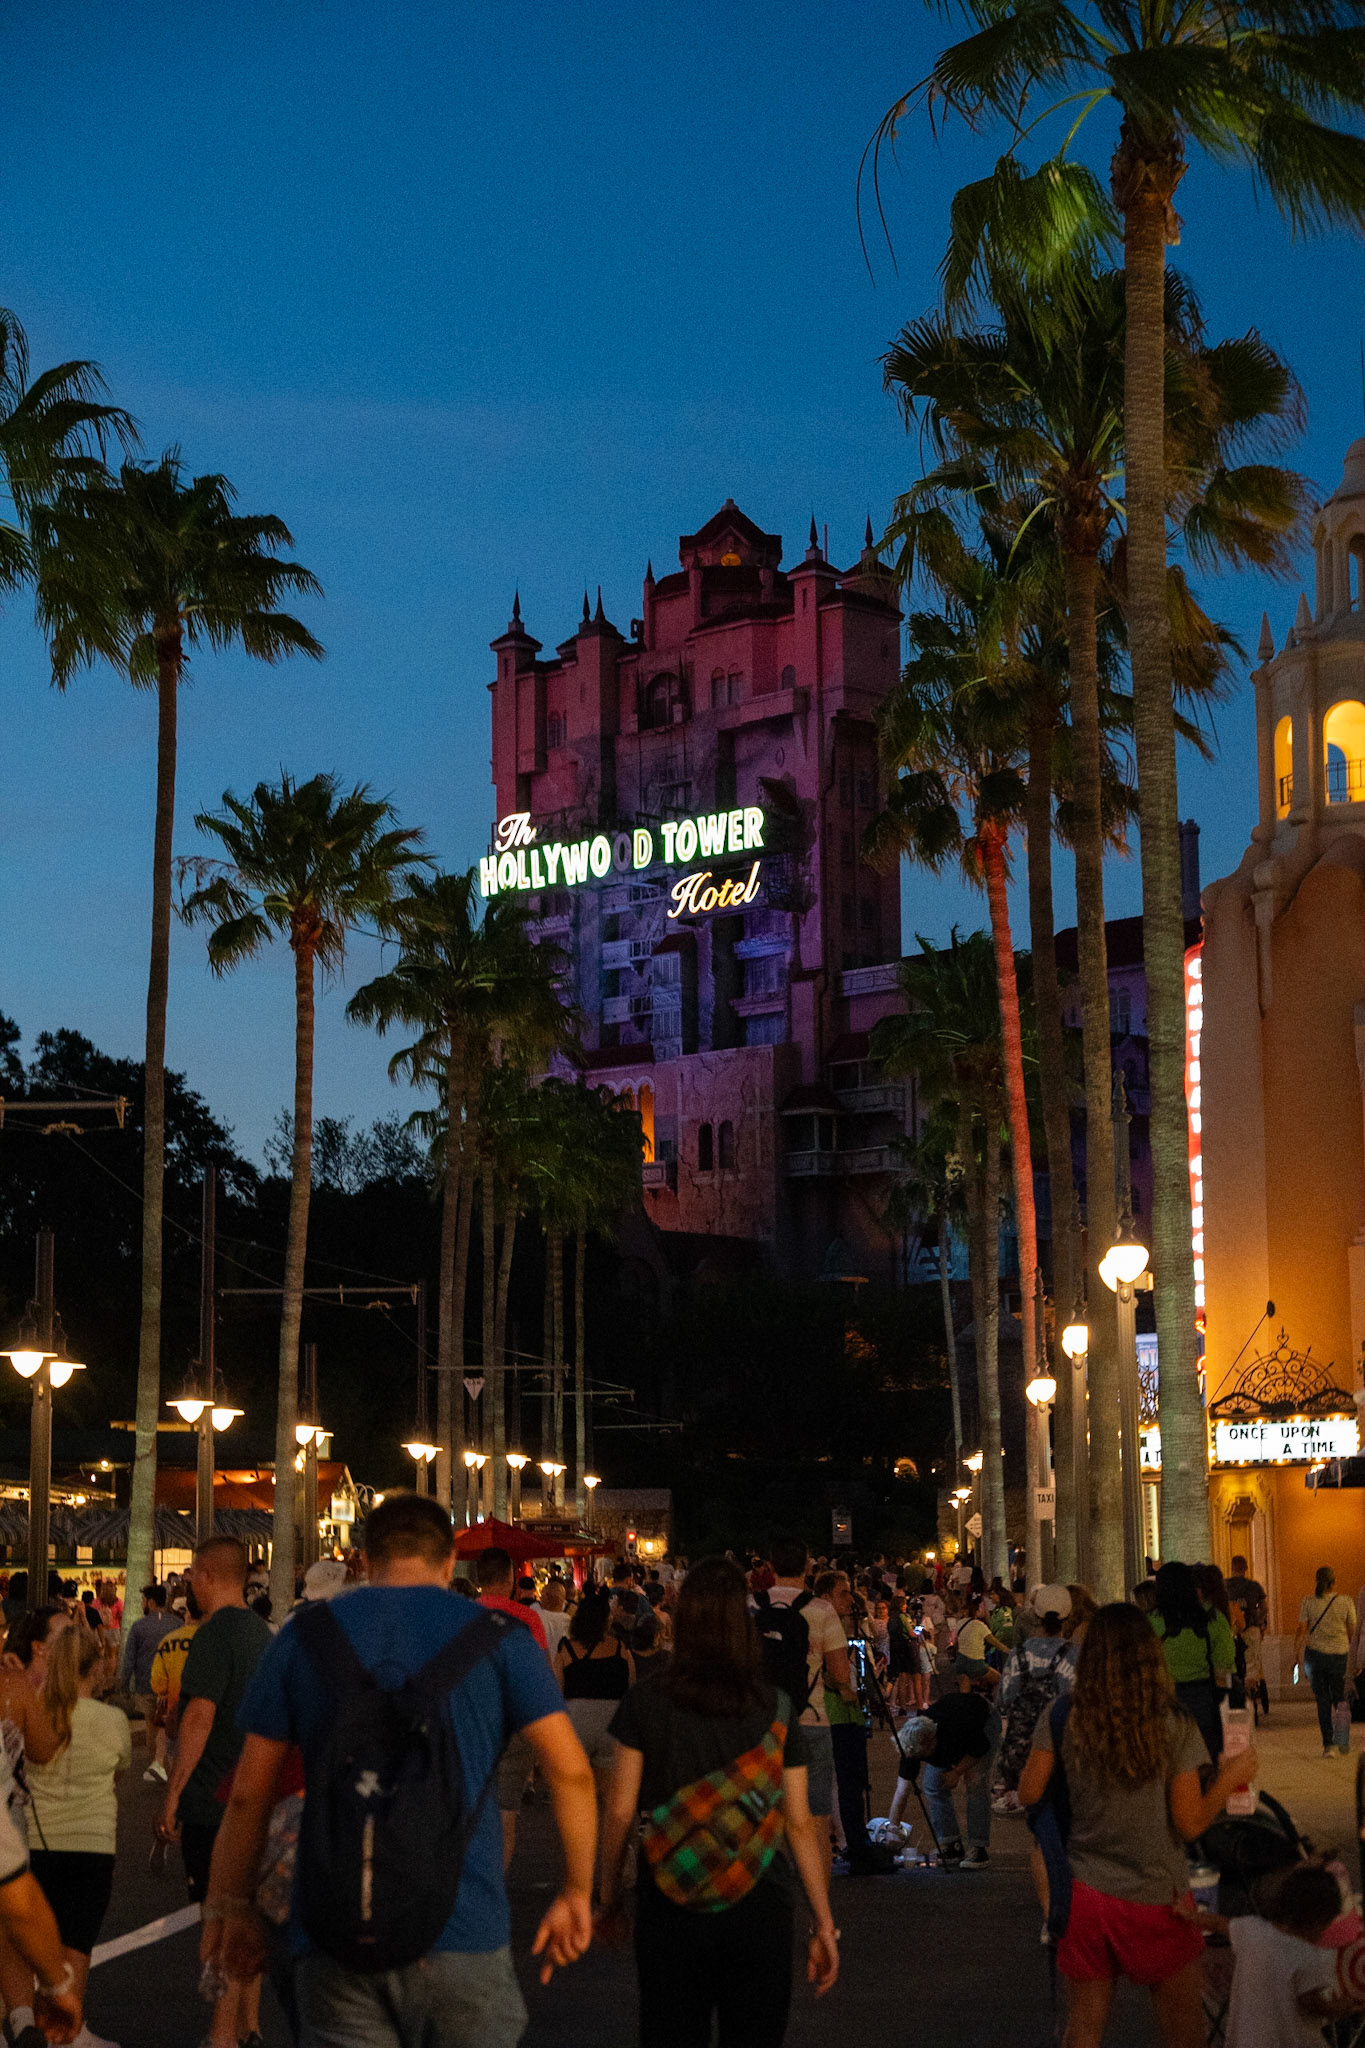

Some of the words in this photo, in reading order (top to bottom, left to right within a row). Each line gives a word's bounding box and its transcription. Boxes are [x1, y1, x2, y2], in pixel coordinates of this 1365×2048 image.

[480, 829, 653, 897] HOLLYWOOD
[660, 806, 765, 864] TOWER
[667, 861, 761, 919] Hotel
[1228, 1427, 1269, 1440] ONCE
[1280, 1425, 1321, 1439] UPON
[1282, 1443, 1293, 1455] A
[1302, 1440, 1338, 1454] TIME
[1037, 1494, 1054, 1504] TAXI
